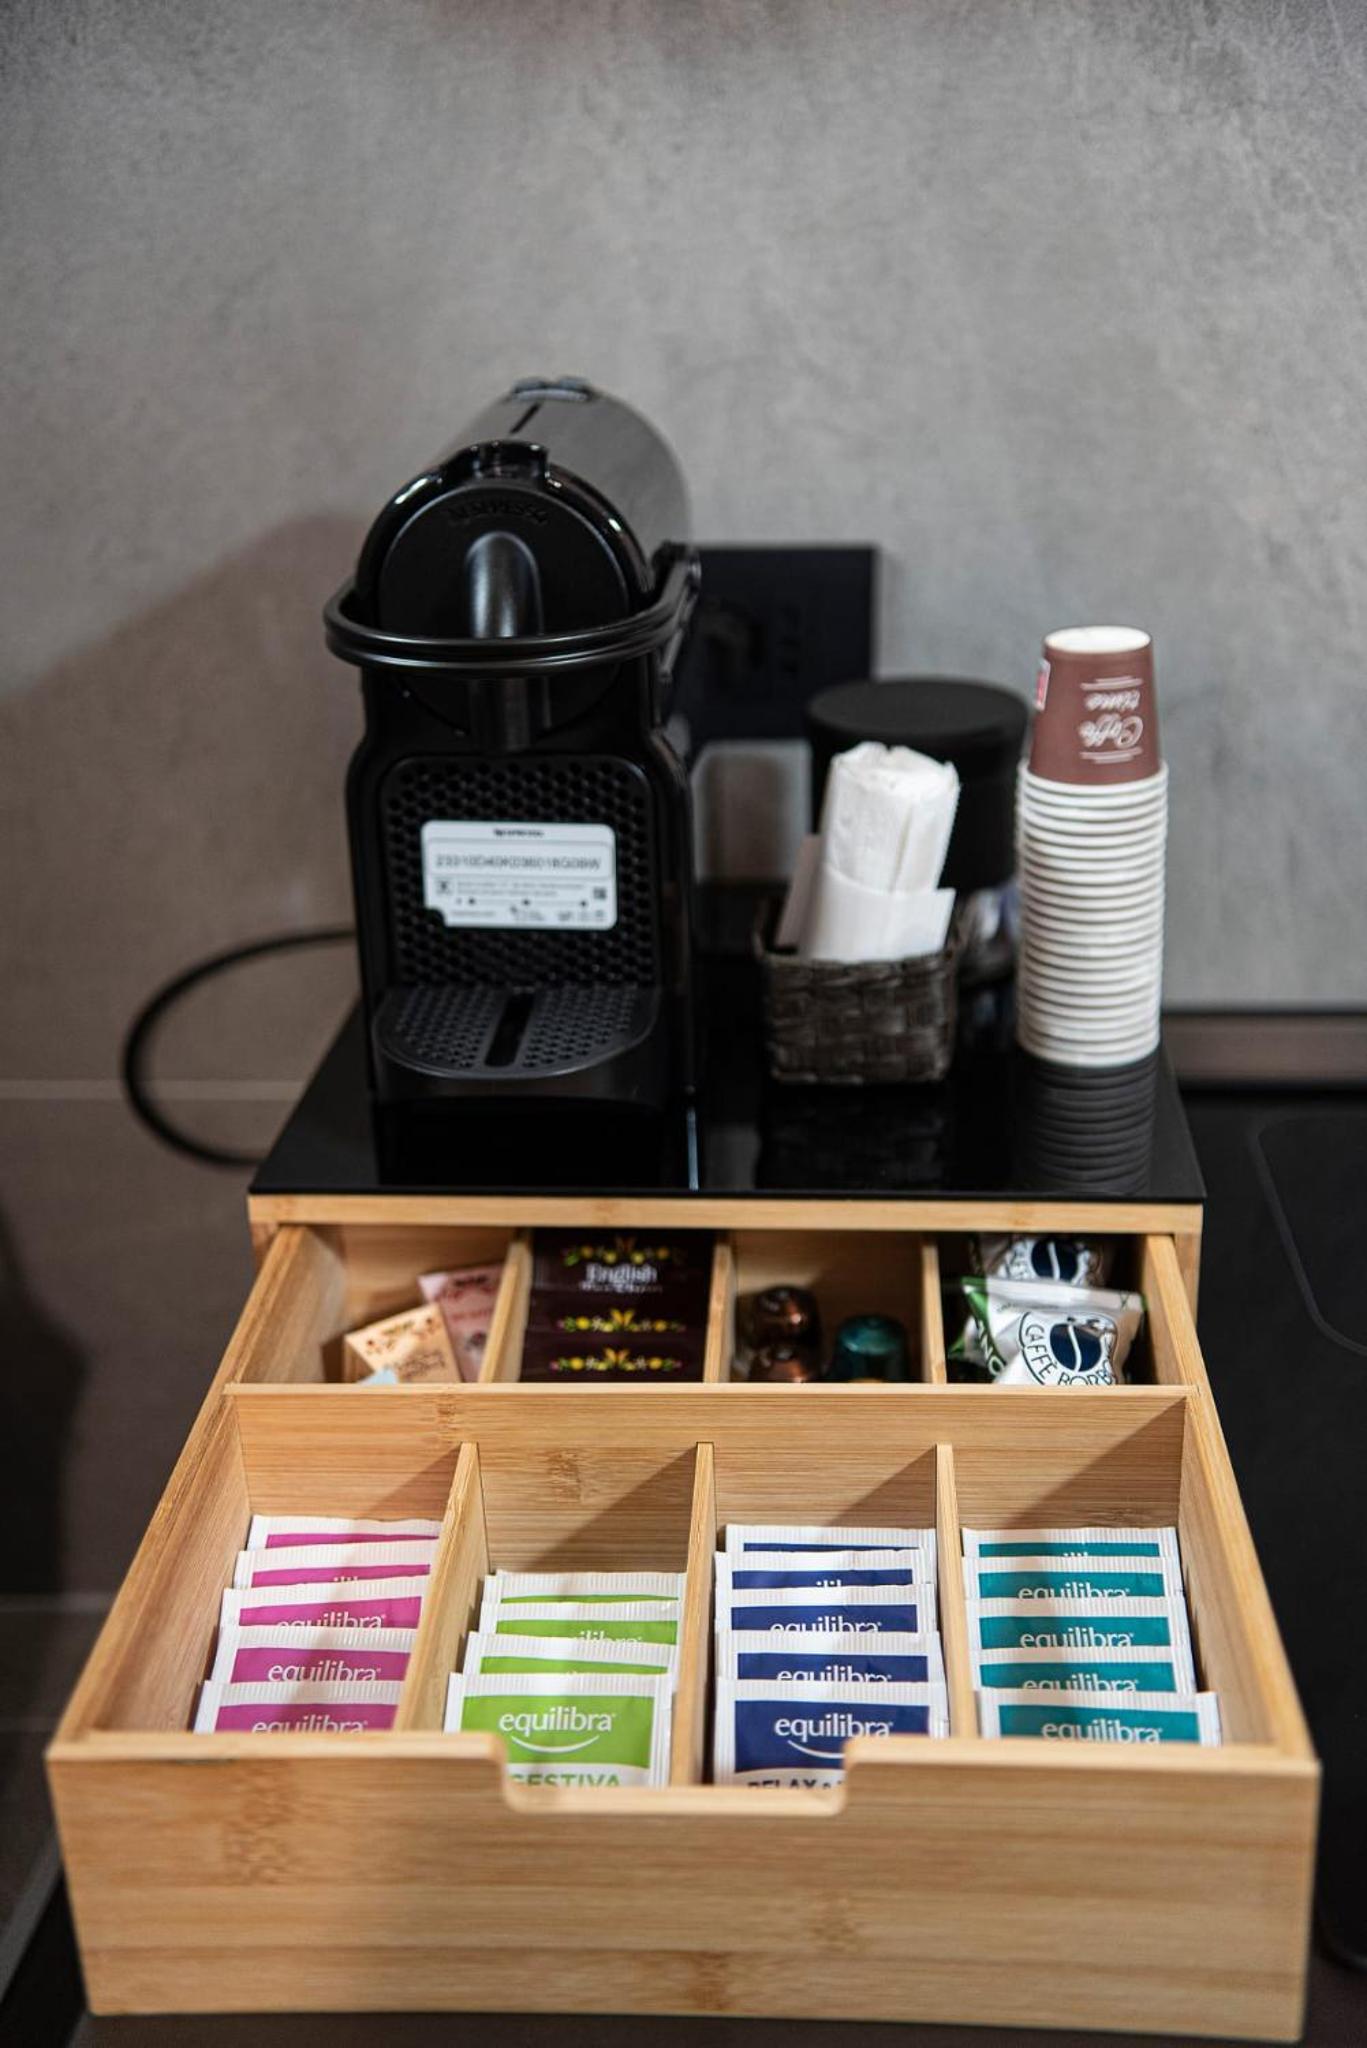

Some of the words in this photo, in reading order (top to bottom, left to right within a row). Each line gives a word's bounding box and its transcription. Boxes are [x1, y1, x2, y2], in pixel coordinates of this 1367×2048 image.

[1020, 1627, 1132, 1648] equilibra
[268, 1660, 377, 1681] equilibra
[499, 1706, 612, 1737] equilibra
[774, 1713, 890, 1743] equilibra
[1042, 1718, 1161, 1744] equilibra
